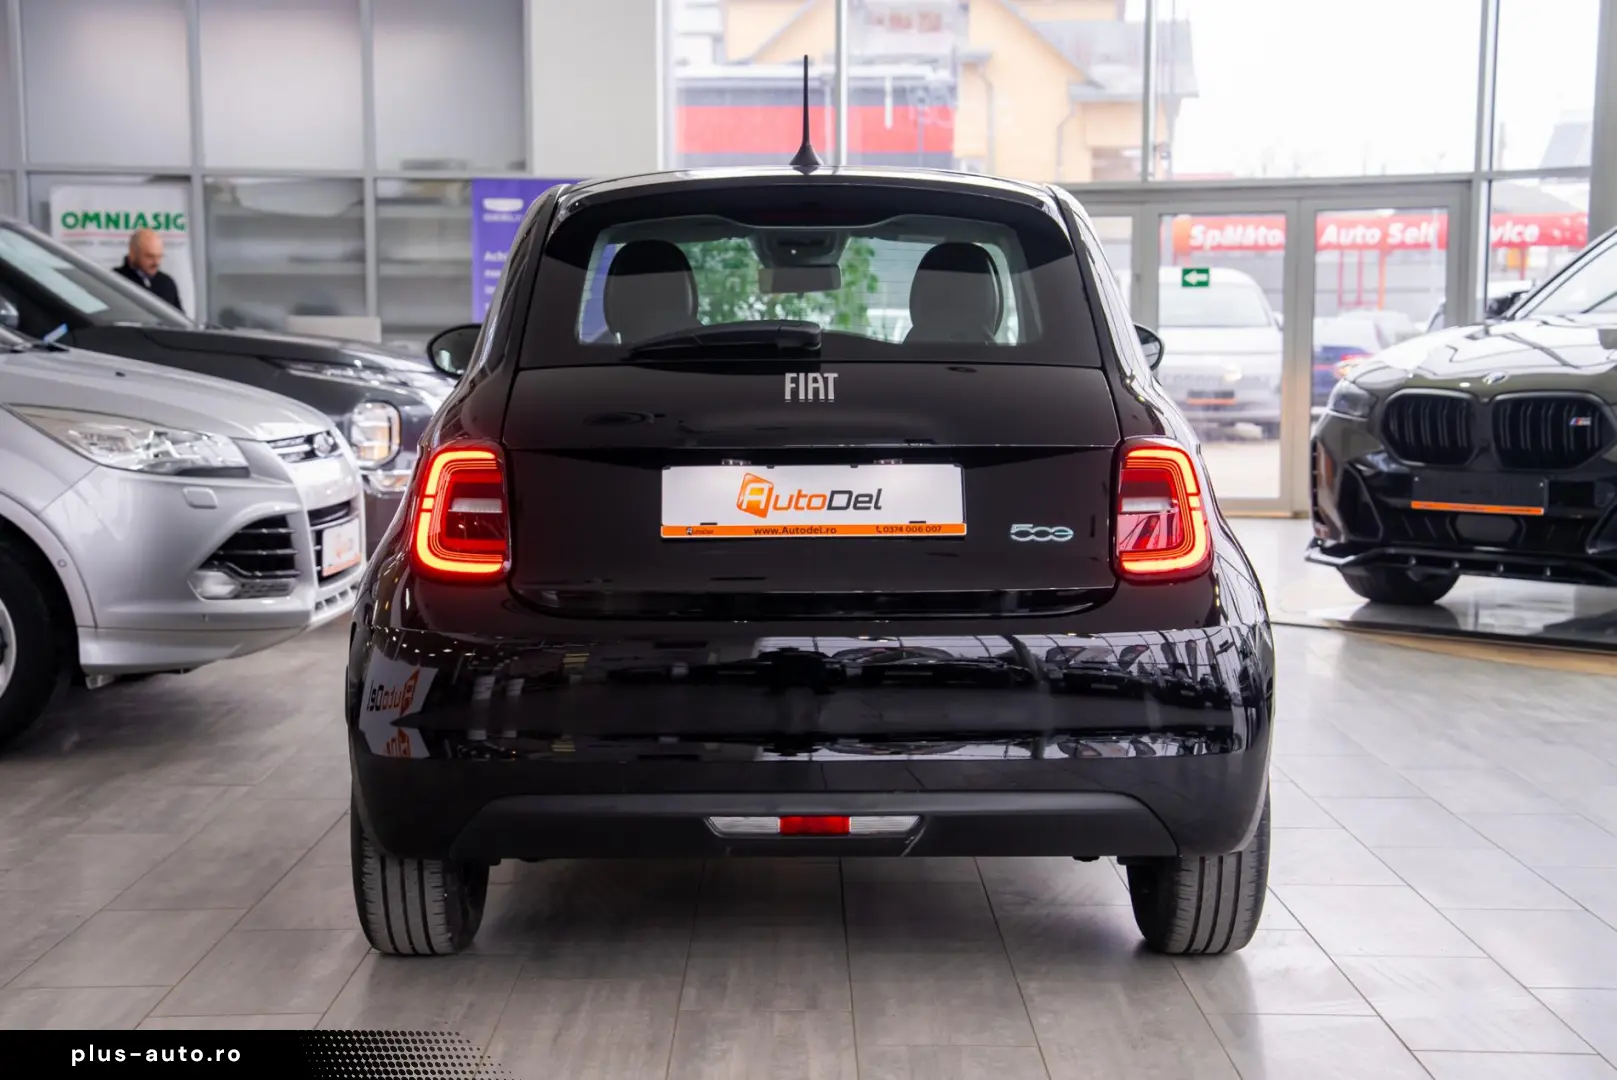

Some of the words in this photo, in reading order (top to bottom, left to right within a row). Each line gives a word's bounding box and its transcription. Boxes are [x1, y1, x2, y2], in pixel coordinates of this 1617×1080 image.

[61, 211, 186, 231] OMNIASIG
[1319, 224, 1381, 246] Auto
[784, 372, 839, 400] FIAT
[738, 476, 883, 516] AutoDel
[753, 526, 837, 535] www.Autodel.ro
[883, 525, 904, 533] 0374
[926, 524, 942, 533] 007
